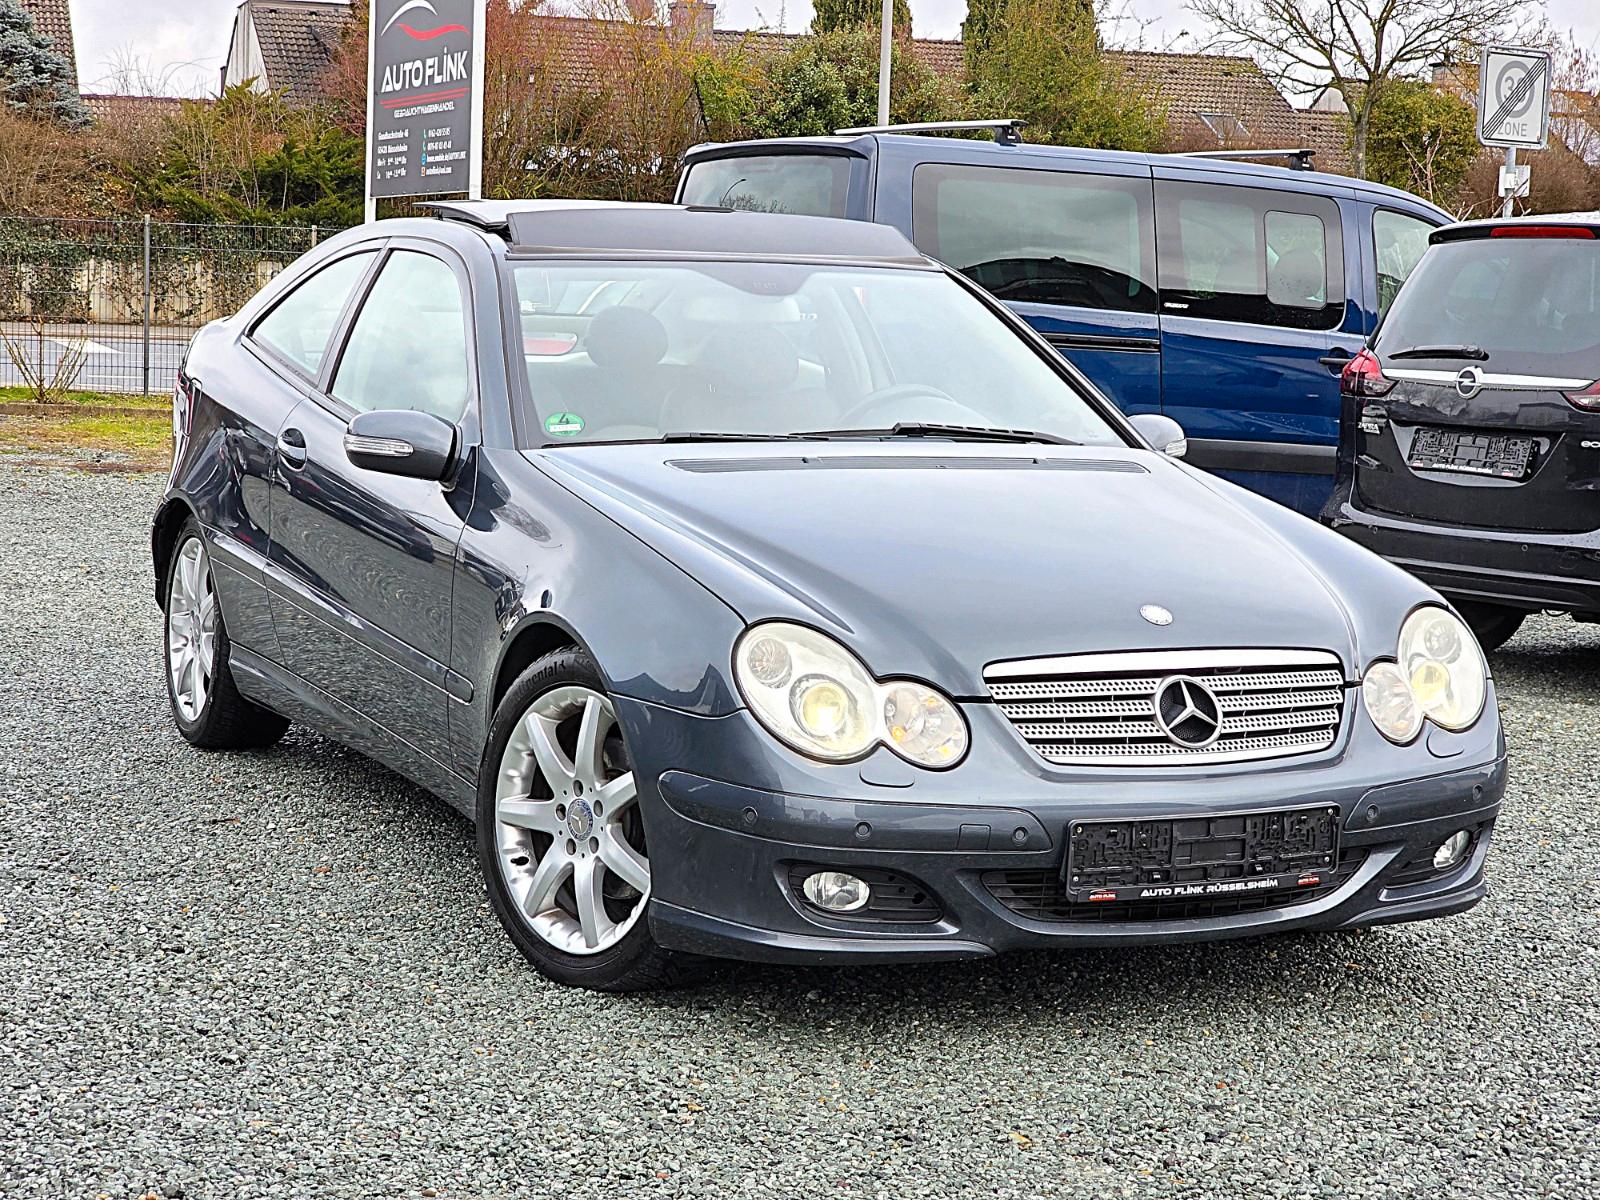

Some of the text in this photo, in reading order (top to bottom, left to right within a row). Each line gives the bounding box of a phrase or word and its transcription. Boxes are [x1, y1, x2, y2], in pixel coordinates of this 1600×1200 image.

[381, 59, 424, 93] AUTO
[1497, 122, 1528, 137] ZONE
[1140, 888, 1171, 897] AUTO
